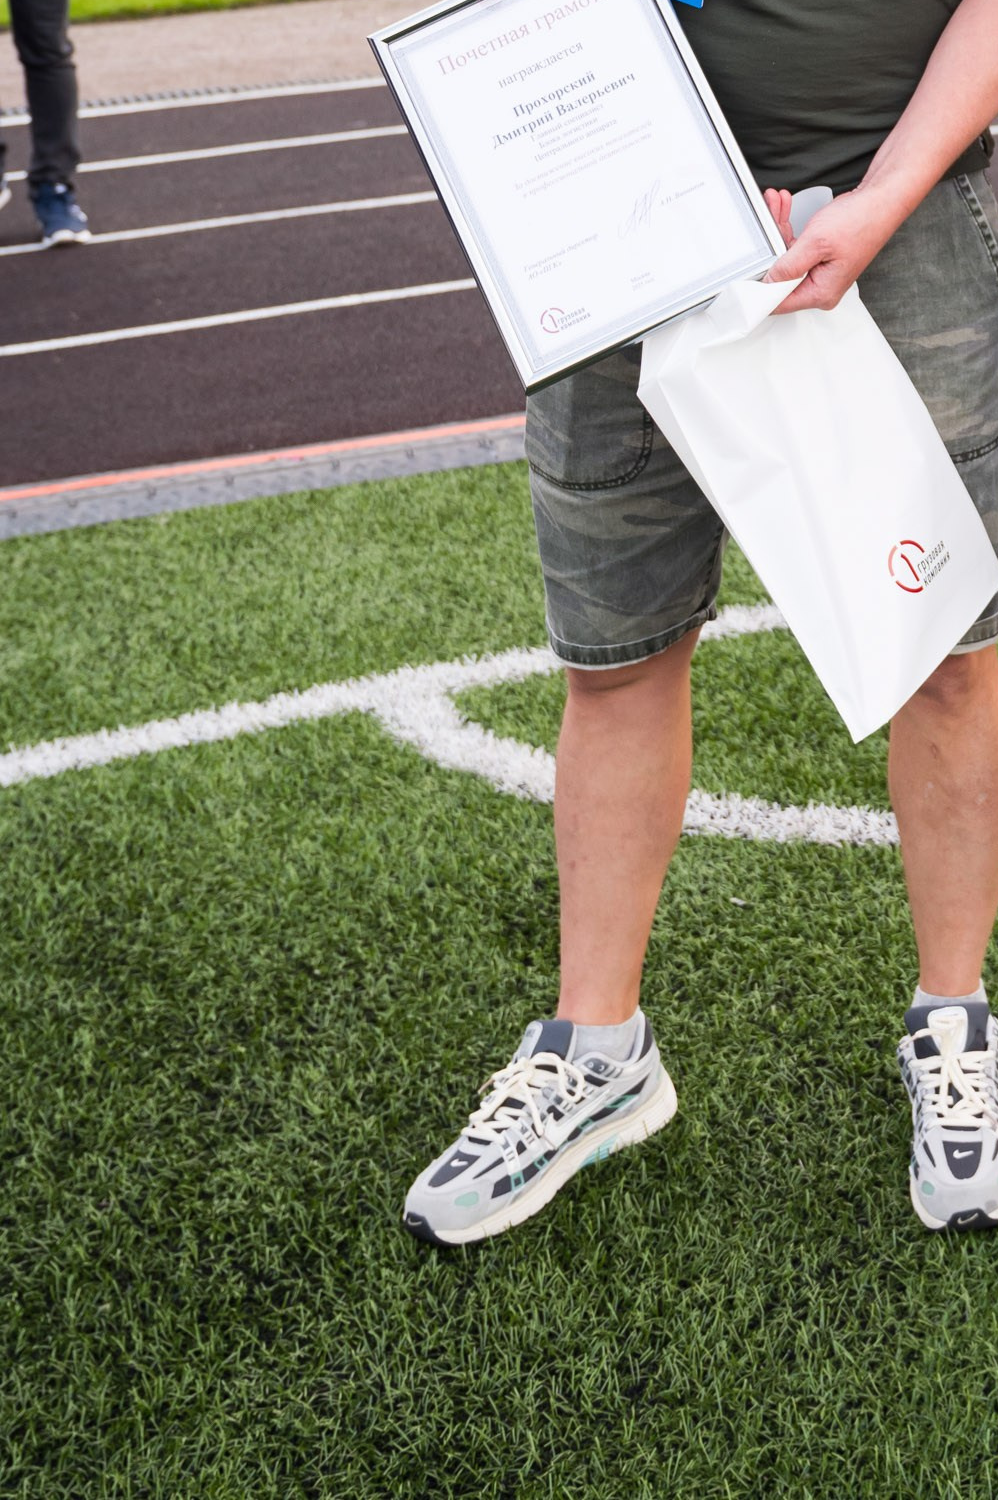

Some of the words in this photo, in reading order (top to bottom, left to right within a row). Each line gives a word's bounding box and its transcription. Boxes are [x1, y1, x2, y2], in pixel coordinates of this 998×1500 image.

[437, 24, 531, 76] Почетная
[498, 42, 584, 89] награждается
[493, 110, 554, 150] Дмитрий
[555, 73, 636, 117] Валерьевич
[512, 70, 596, 118] Прохорский
[917, 540, 946, 574] грузовая
[923, 551, 951, 587] компания
